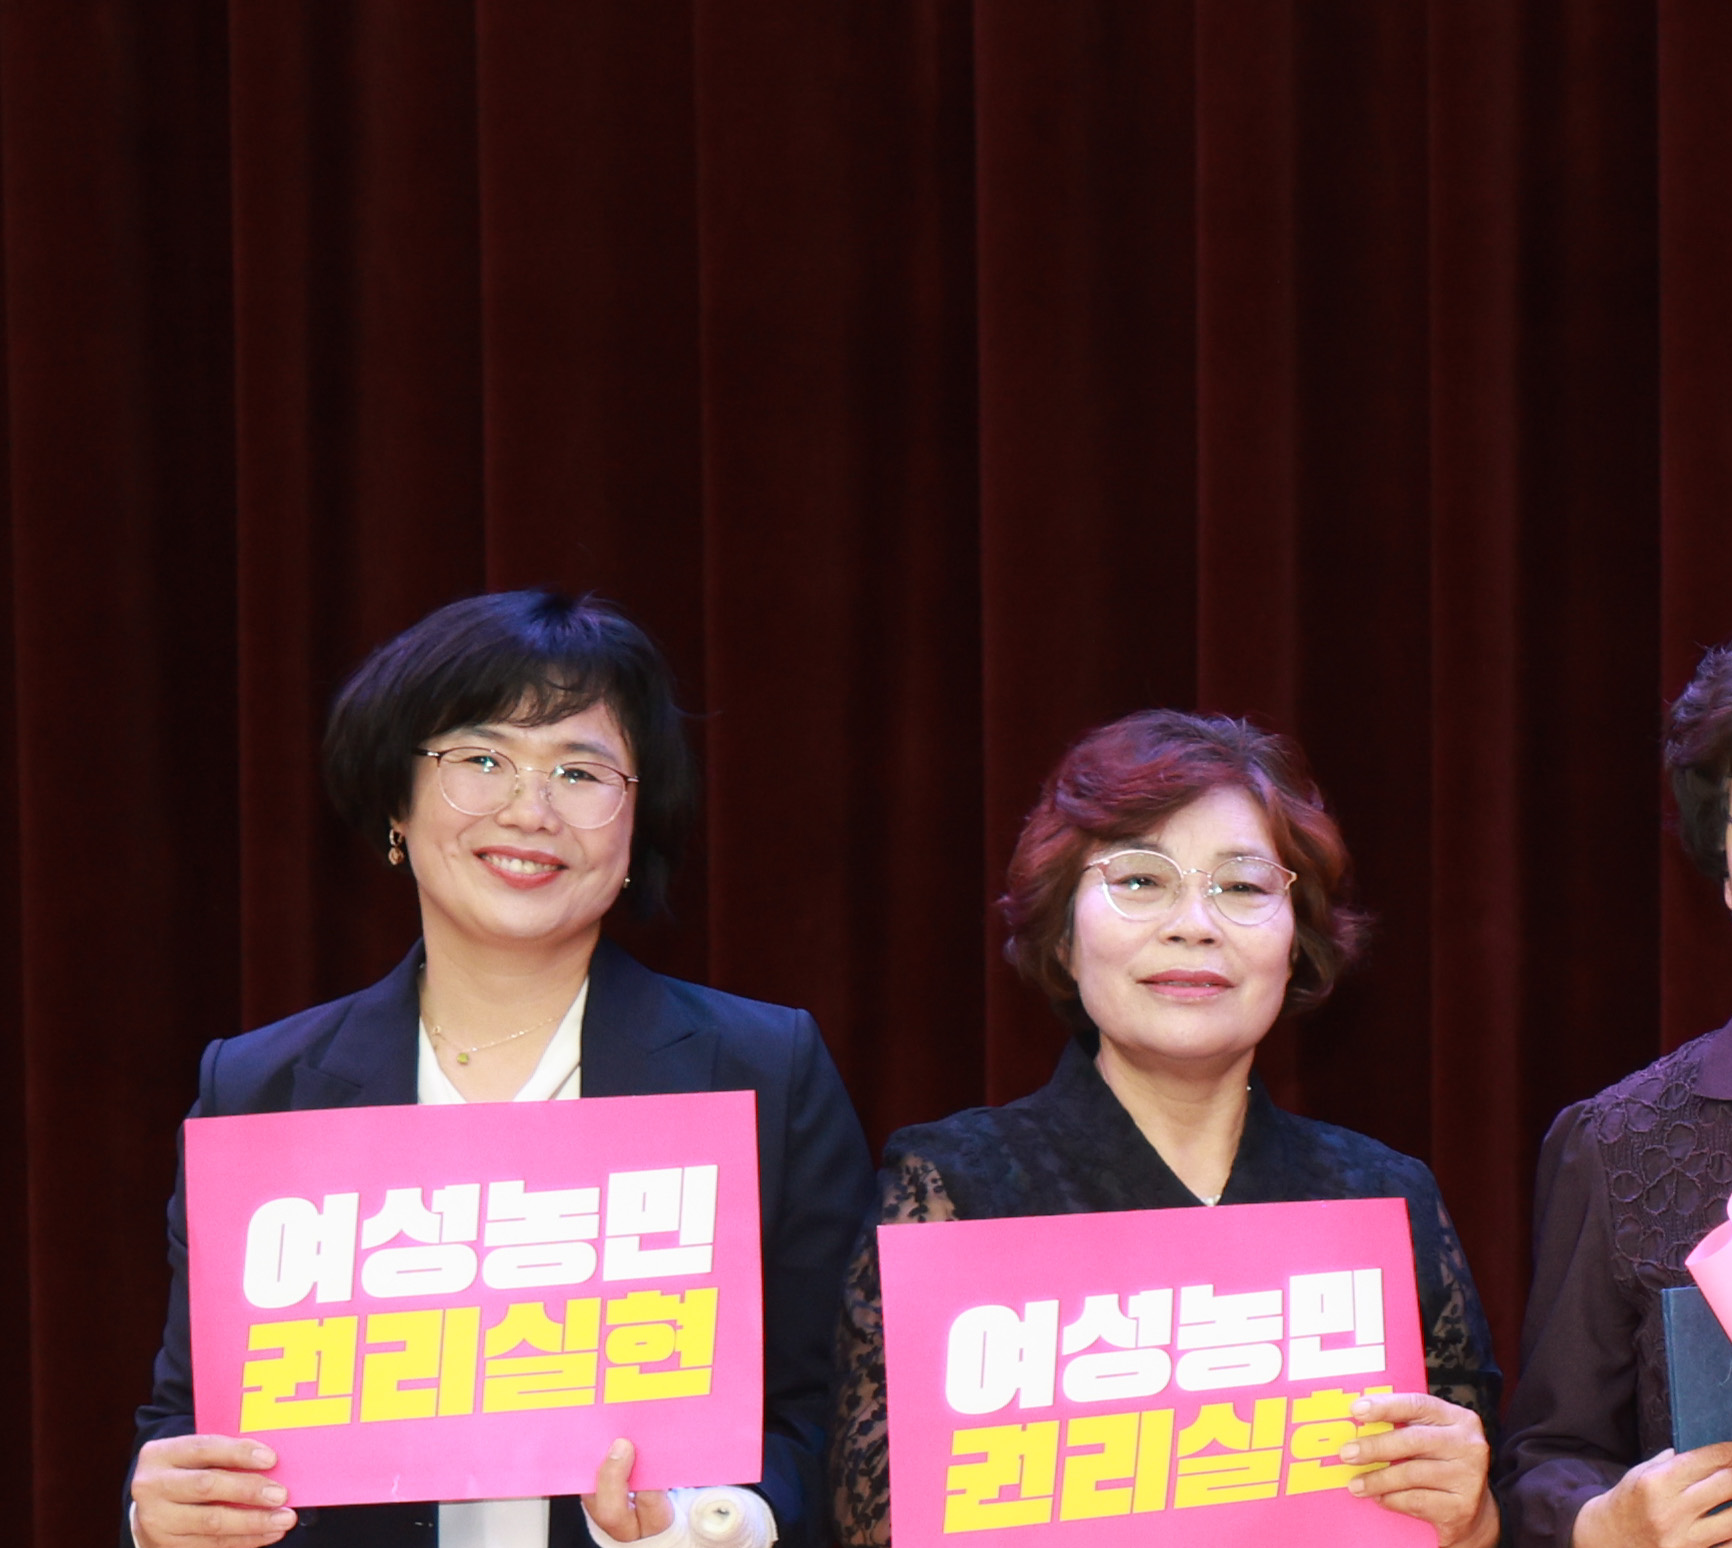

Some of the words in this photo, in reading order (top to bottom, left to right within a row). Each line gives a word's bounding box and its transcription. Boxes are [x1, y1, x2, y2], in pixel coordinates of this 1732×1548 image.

[242, 1164, 719, 1309] 여성농민
[239, 1287, 719, 1433] 권리실현
[944, 1267, 1386, 1415] 여성농민
